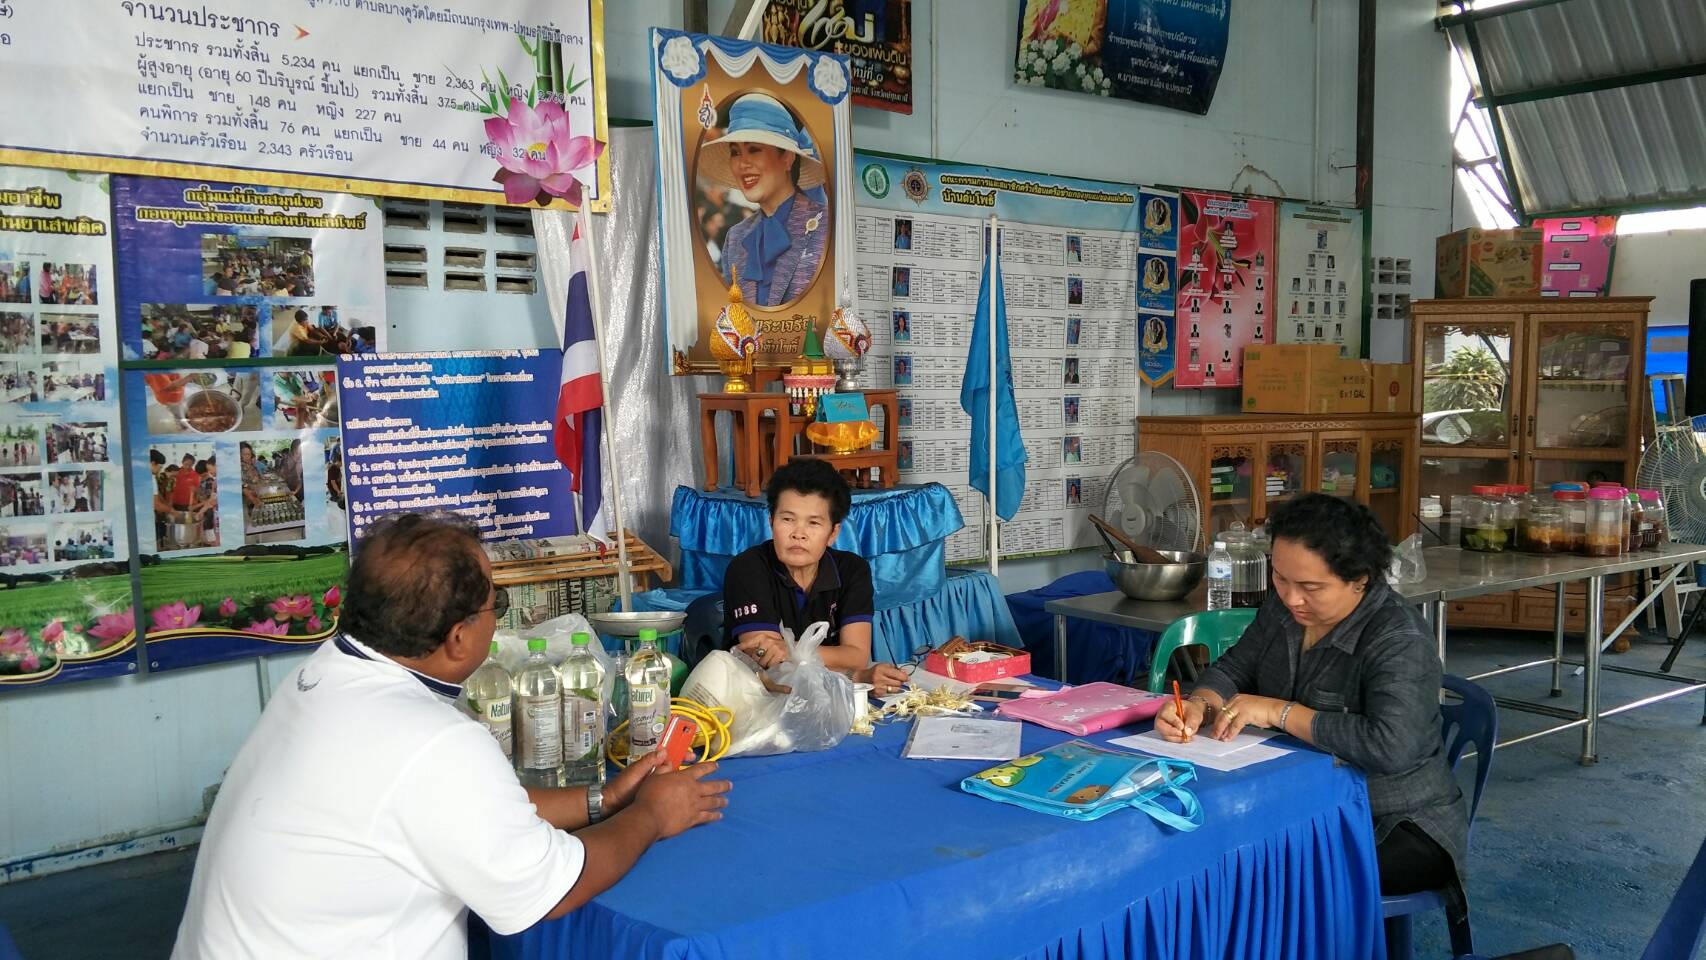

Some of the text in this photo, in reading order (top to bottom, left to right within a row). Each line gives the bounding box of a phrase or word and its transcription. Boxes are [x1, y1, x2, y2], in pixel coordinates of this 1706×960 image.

[121, 0, 280, 38] จำนวนประชากร
[135, 32, 200, 54] ประชากร
[206, 39, 270, 64] รวมทั้งสิ้น
[281, 54, 315, 69] 5,234
[322, 60, 340, 73] คน
[353, 63, 400, 81] แยกเป็น
[413, 71, 436, 85] ชาย
[445, 76, 474, 91] 2,363
[480, 82, 496, 95] คน
[505, 84, 529, 101] หญิง
[571, 94, 586, 106] คน
[137, 53, 481, 113] ผู้สูงอายุ (อายุ 60 ปีบริบูรณ์ ขึ้นไป) รวมทั้งสิ้น 375 คน
[138, 82, 402, 124] แยกเป็น ชาย 148 คน หญิง 227 คน
[140, 104, 546, 161] คนพิการ รวมทั้งสิ้น 76 คน แยกเป็น ชาย 44 คน หญิง 32 คน
[141, 126, 353, 162] จำนวนครัวเรือน 2,343 ครัวเรือน
[184, 185, 324, 210] กลุ่มแม่บ้านสมุนไพร
[942, 189, 996, 207] บ้านต้นโพธิ์
[137, 206, 368, 231] กองทุนแม่ของแผ่นดินบ้านต้นโพธิ์
[733, 603, 758, 619] 1386
[631, 689, 653, 702] aturel
